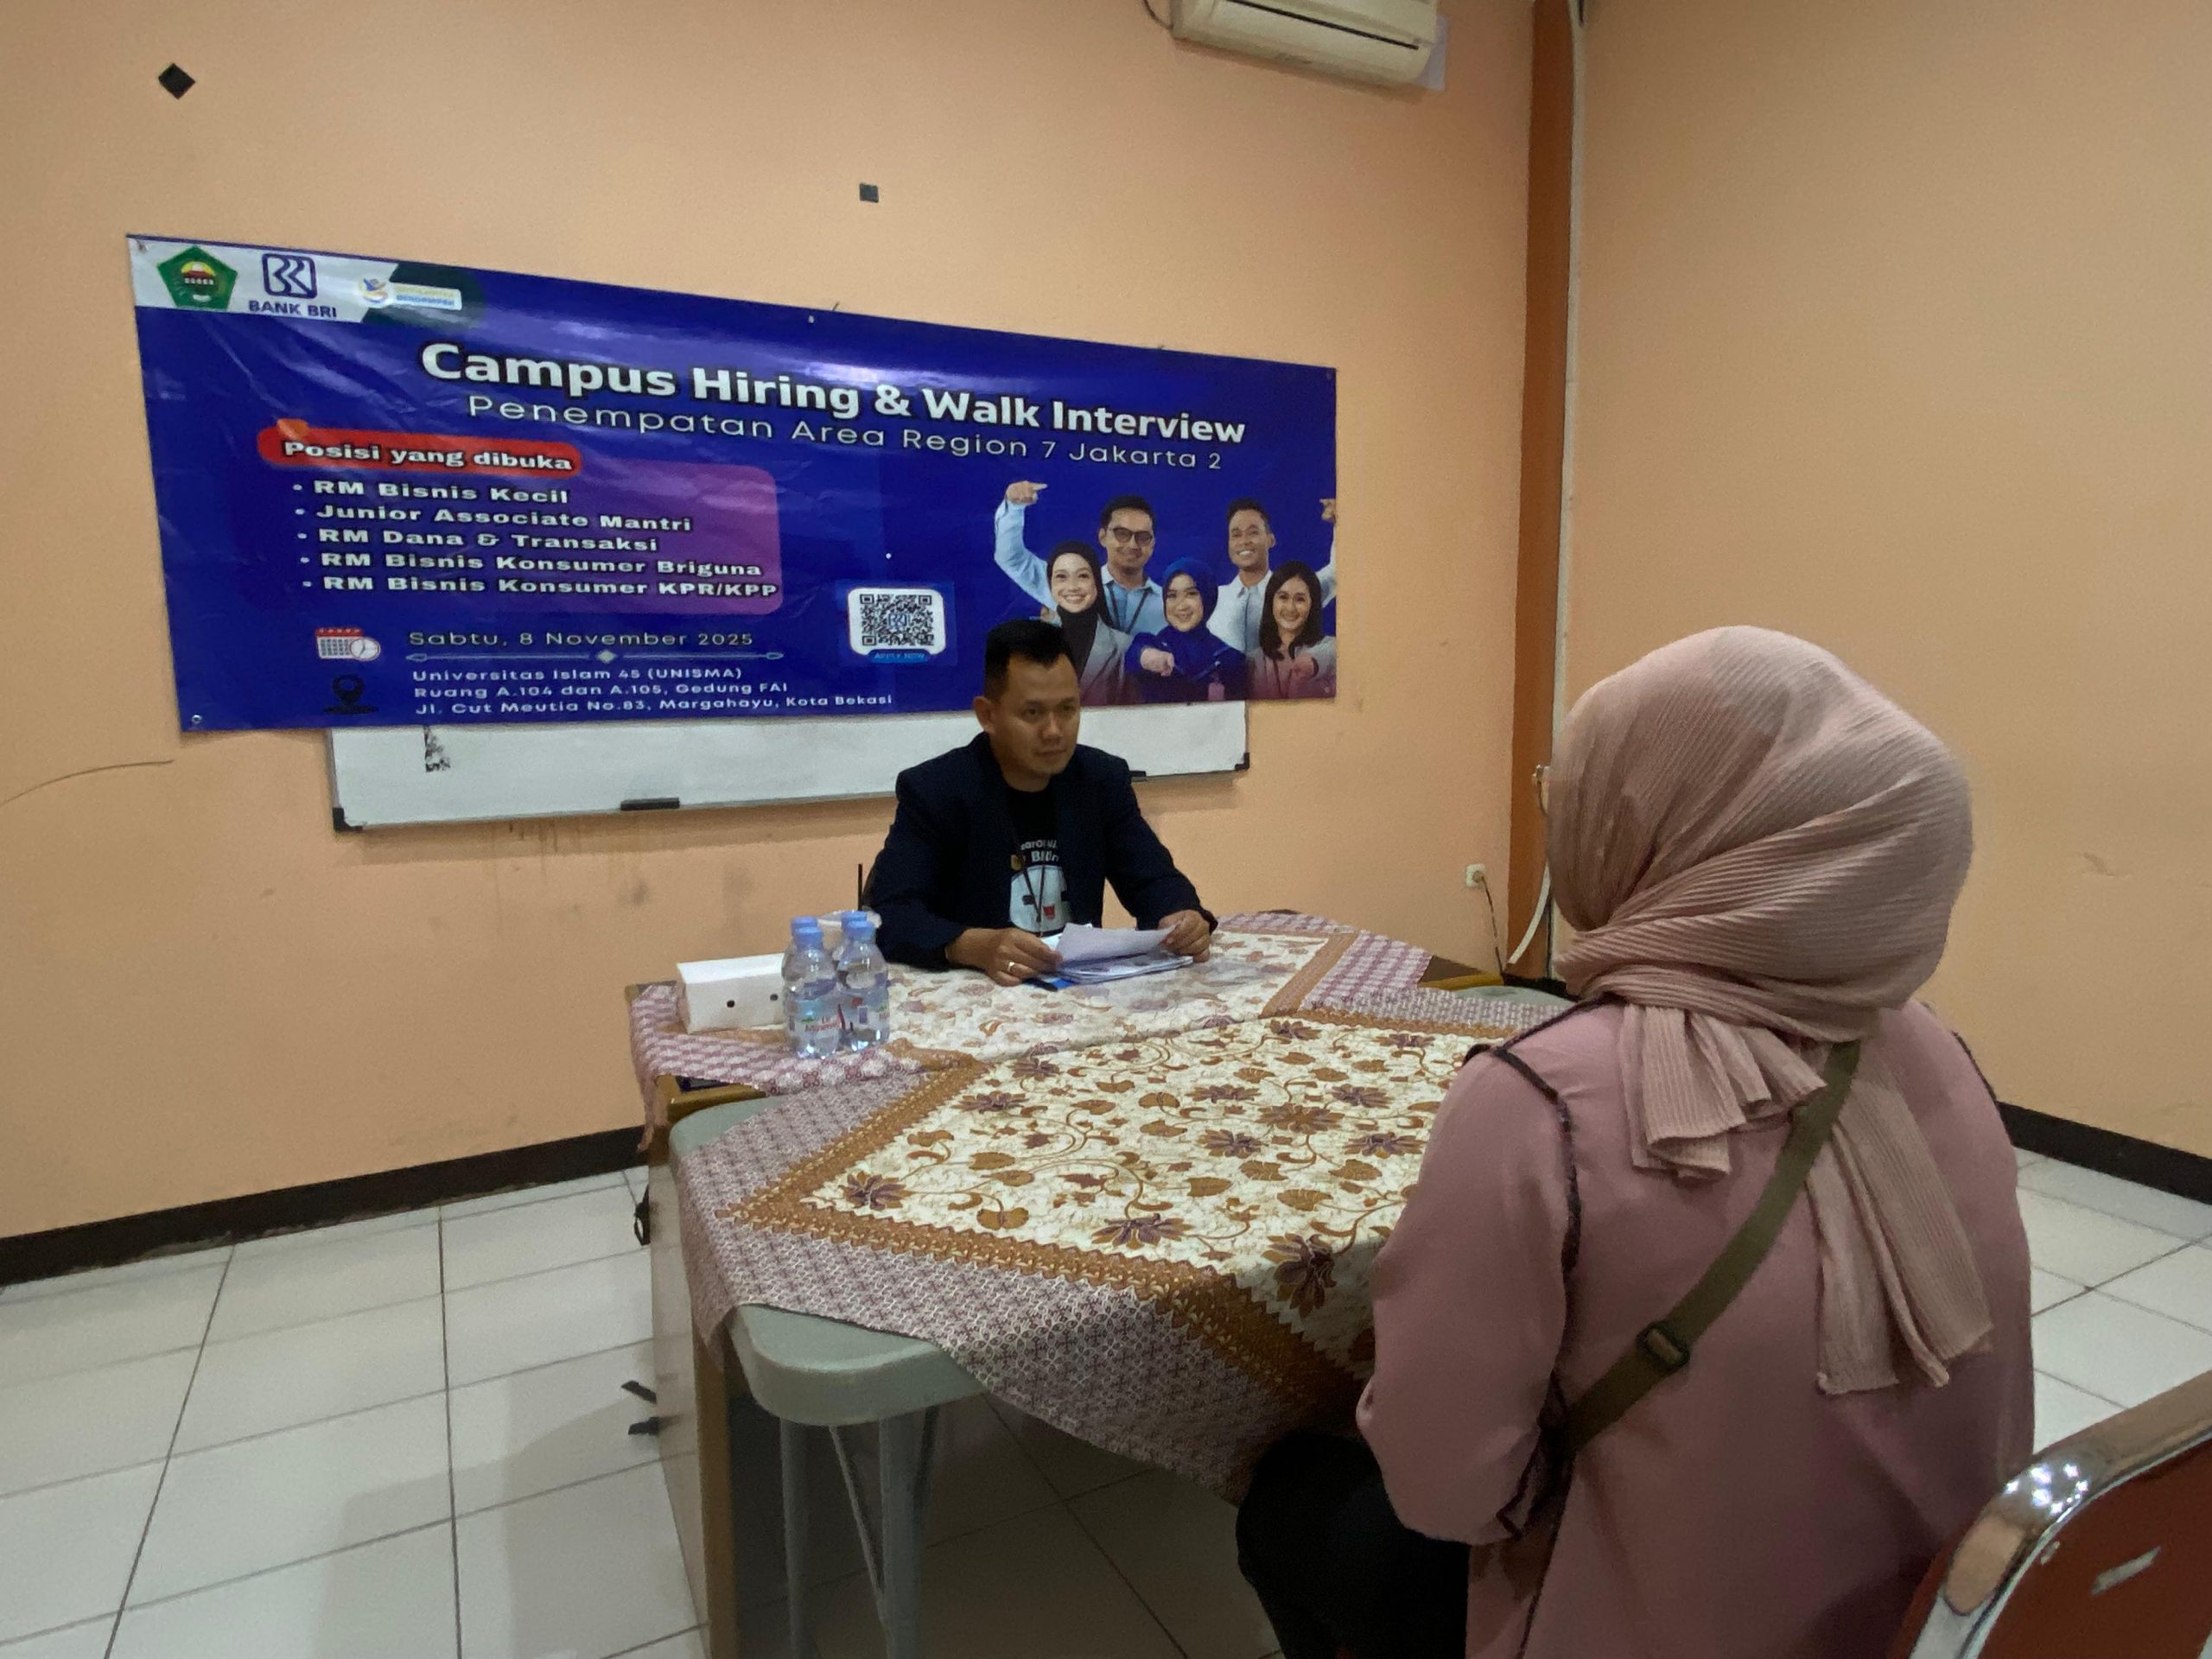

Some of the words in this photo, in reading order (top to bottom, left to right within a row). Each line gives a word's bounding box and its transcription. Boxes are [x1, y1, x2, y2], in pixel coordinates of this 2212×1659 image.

[249, 300, 301, 315] BANK
[308, 305, 337, 318] BRI
[421, 343, 677, 397] Campus
[693, 366, 860, 420] Hiring
[874, 384, 911, 417] &
[922, 387, 1040, 429] Walk
[1052, 400, 1247, 444] Interview
[468, 394, 773, 439] Penempatan
[791, 420, 884, 447] Area
[903, 428, 1027, 457] Region
[1041, 441, 1055, 459] 7
[1069, 442, 1197, 467] Jakarta
[1207, 452, 1222, 470] 2
[284, 442, 380, 460] Posisi
[390, 448, 464, 467] yang
[473, 450, 573, 471] dibuka
[314, 480, 365, 495] RM
[378, 482, 478, 500] Bisnis
[490, 487, 569, 504] Kecil
[316, 505, 422, 520] Junior
[433, 508, 588, 527] Associate
[600, 514, 691, 531] Mantri
[318, 528, 369, 543] RM
[383, 530, 464, 546] Dana
[476, 533, 499, 547] &
[511, 533, 658, 551] Transaksi
[321, 552, 371, 567] RM
[385, 554, 484, 569] Bisnis
[496, 556, 645, 572] Konsumer
[657, 560, 762, 578] Briguna
[323, 576, 373, 590] RM
[387, 577, 486, 592] Bisnis
[498, 579, 648, 594] Konsumer
[658, 582, 778, 597] KPR/KPP
[408, 632, 508, 647] Sabtu,
[519, 632, 533, 646] 8
[545, 632, 687, 646] November
[697, 632, 753, 646] 2025
[412, 670, 545, 682] Universitas
[552, 670, 611, 680] Islam
[618, 670, 640, 679] 45
[647, 668, 741, 680] (UNISMA)
[414, 688, 487, 700] Ruang
[496, 686, 553, 696] A.104
[561, 685, 601, 696] dan
[676, 683, 753, 695] Gedung
[759, 683, 788, 693] FAI
[451, 703, 493, 714] Cut
[500, 702, 579, 713] Meutia
[658, 697, 779, 710] Margahayu,
[785, 697, 829, 707] Kota
[834, 695, 893, 705] Bekasi
